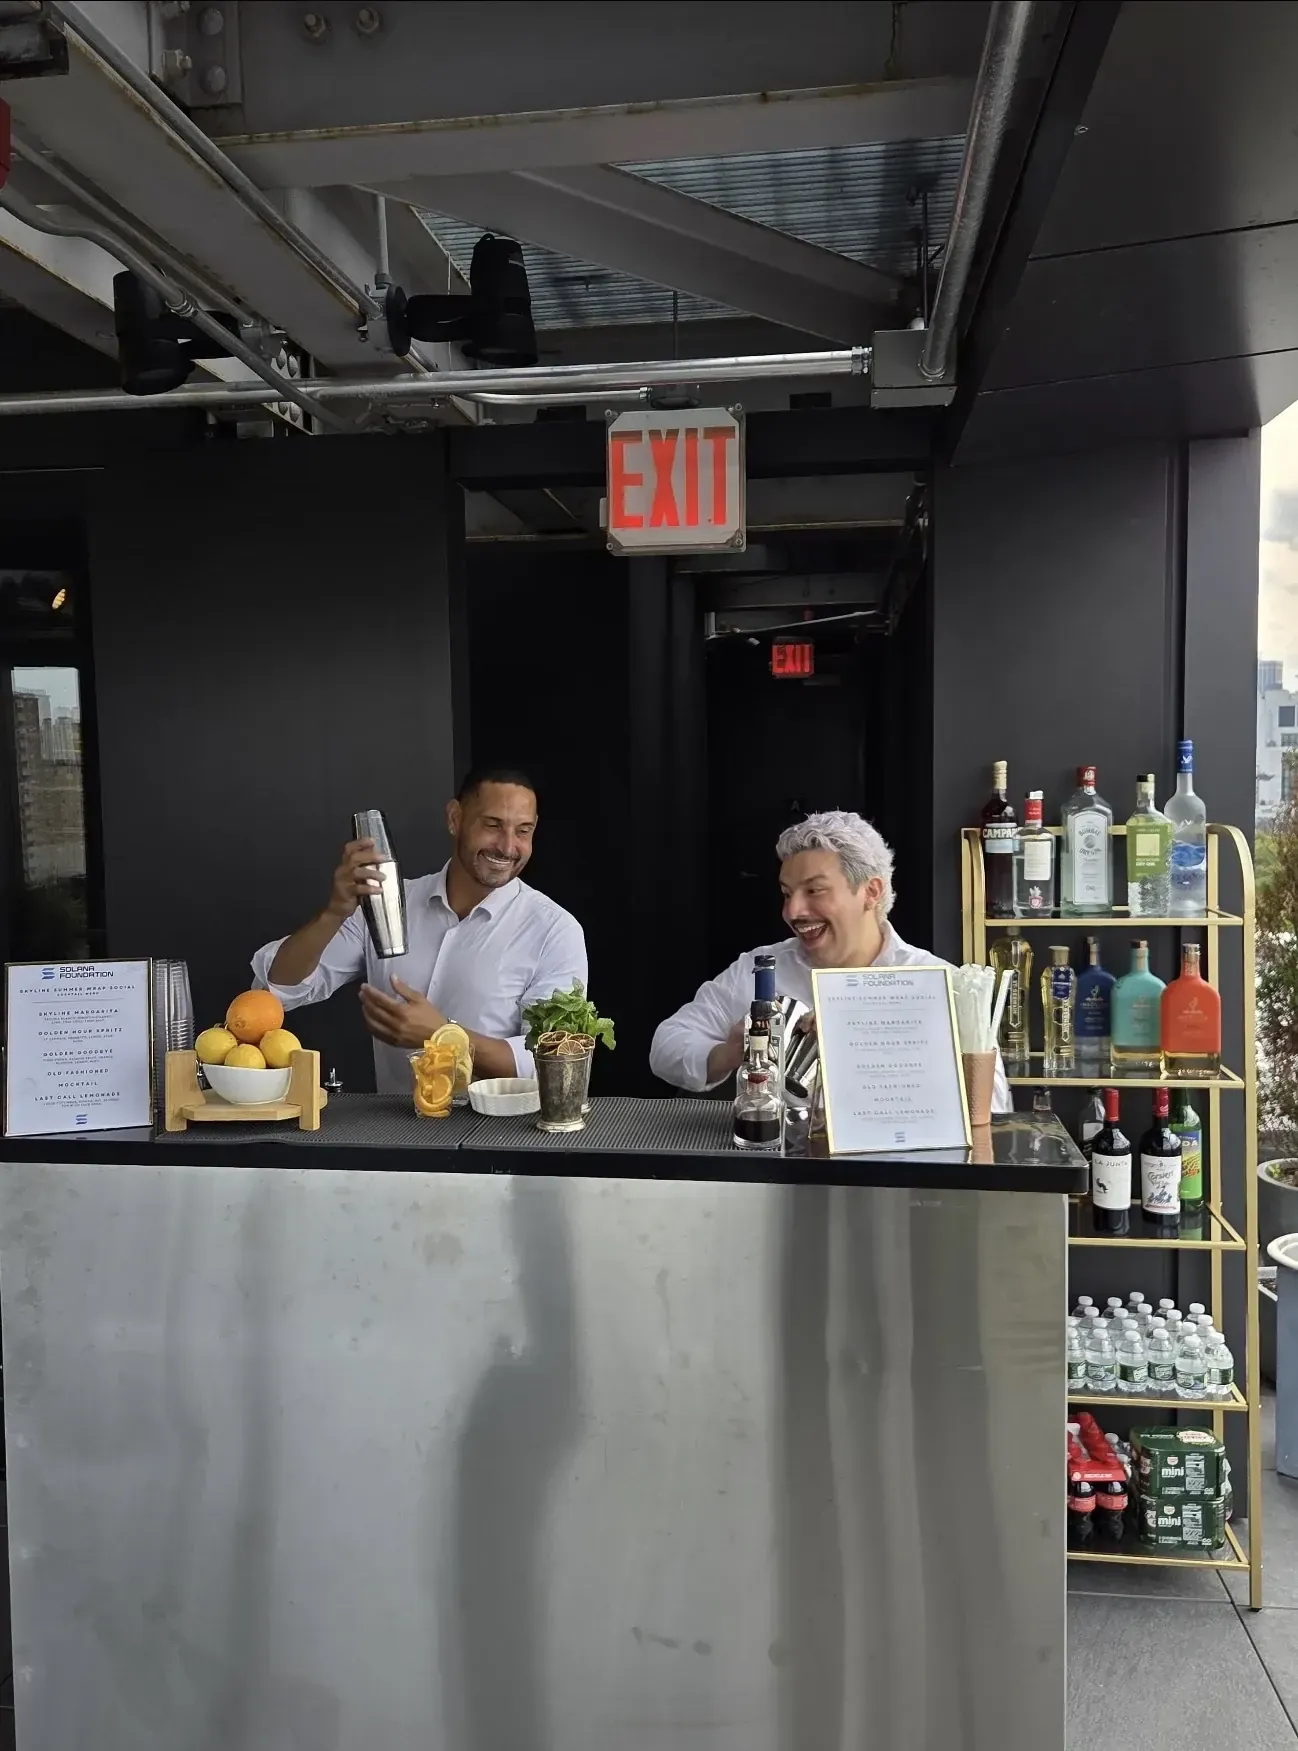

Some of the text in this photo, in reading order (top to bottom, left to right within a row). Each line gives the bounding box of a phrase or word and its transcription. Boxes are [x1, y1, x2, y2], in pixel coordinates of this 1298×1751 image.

[611, 426, 736, 529] EXIT
[772, 644, 811, 673] EXIT
[982, 828, 1019, 839] CAMPAR
[59, 965, 95, 973] SOLANA
[59, 971, 114, 980] FOUNDATION
[862, 979, 914, 987] FOUNDATION
[80, 1091, 121, 1099] LEMONADE
[1161, 1466, 1185, 1477] mini
[1157, 1516, 1182, 1527] mini
